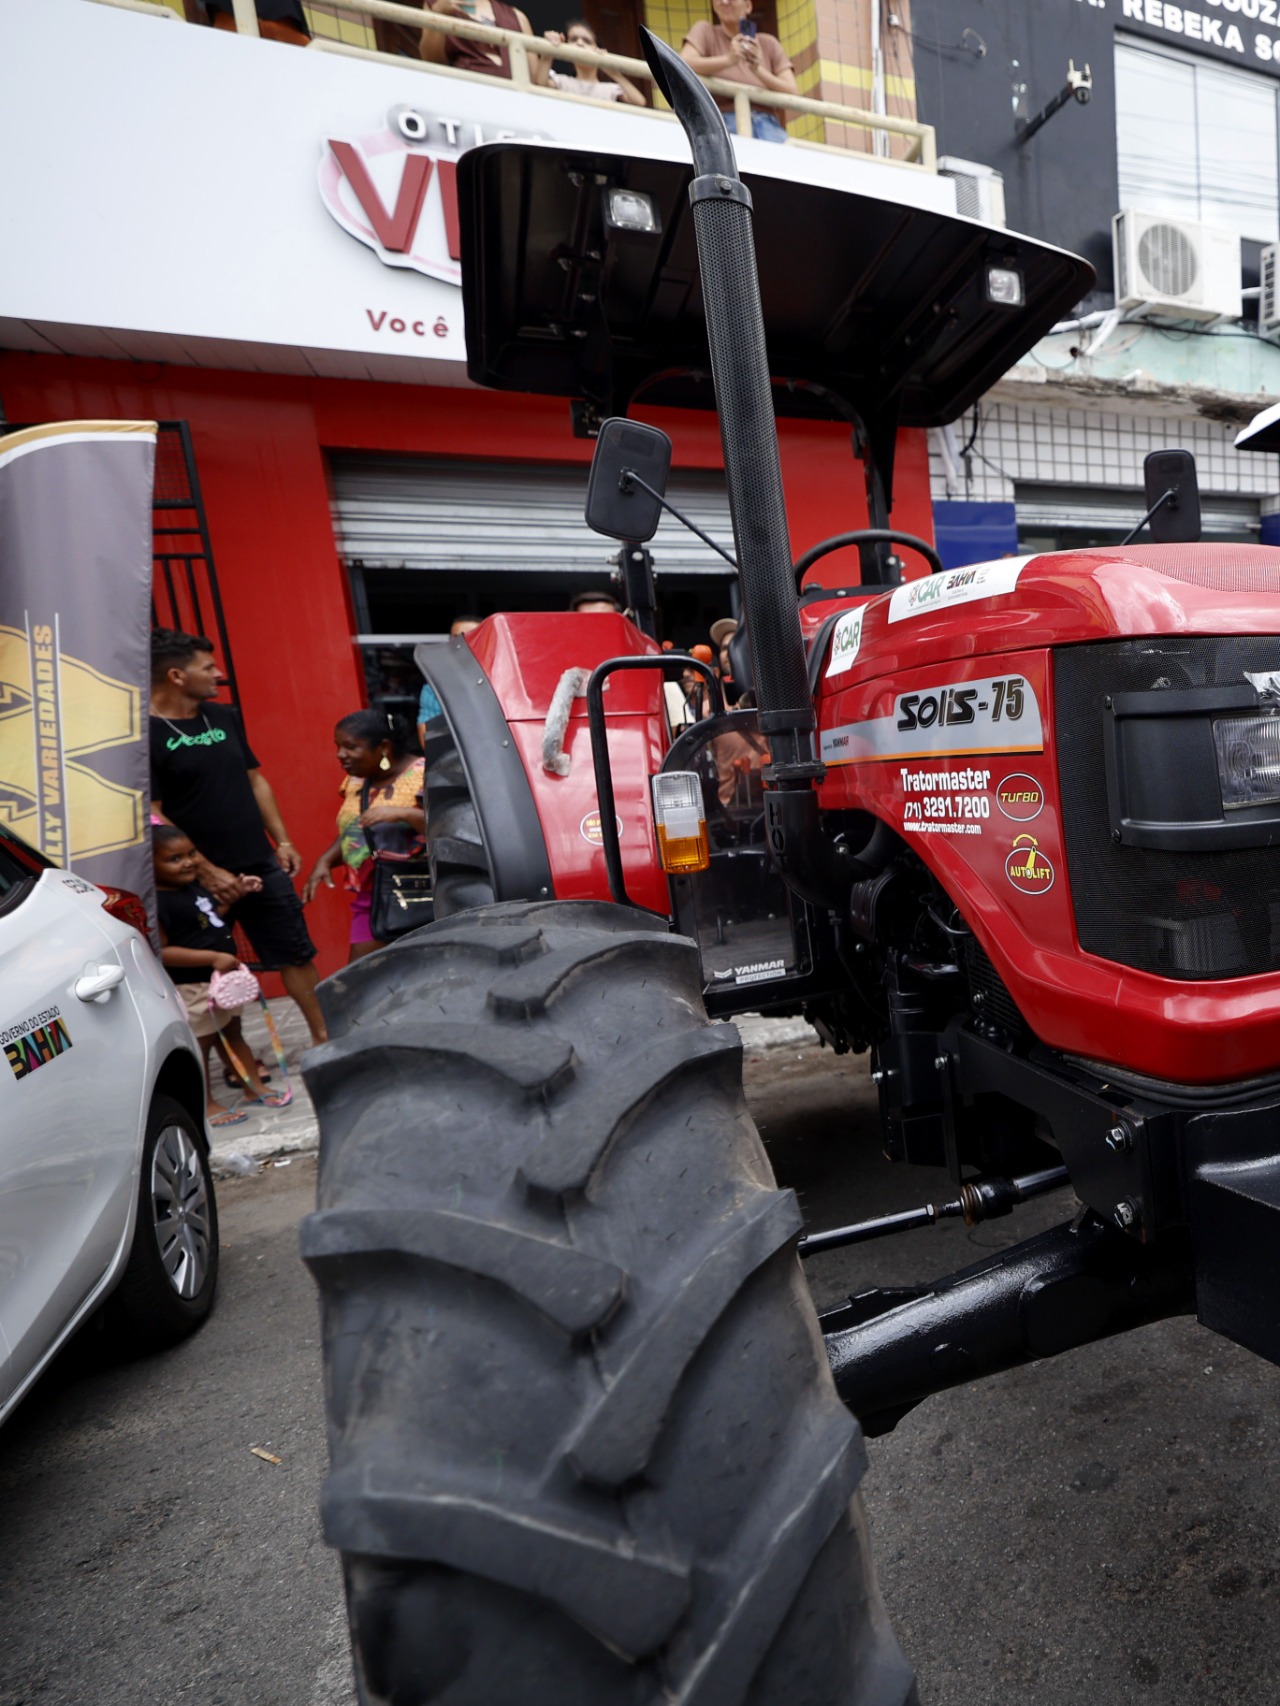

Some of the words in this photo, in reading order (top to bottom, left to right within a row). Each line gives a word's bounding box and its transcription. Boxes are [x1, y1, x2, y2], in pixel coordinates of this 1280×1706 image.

[1122, 0, 1245, 53] REBEKA
[366, 308, 449, 338] Você
[917, 575, 947, 603] CAR
[840, 621, 860, 652] CAR
[33, 624, 60, 806] VARIEDADES
[900, 767, 991, 792] Tratormaster
[903, 801, 922, 820] (71)
[923, 796, 991, 819] 3291.7200
[903, 821, 982, 835] www.tratormaster.com
[1010, 865, 1051, 880] AUTOLIFT
[734, 959, 785, 976] YANMAR
[739, 969, 782, 983] PROTECTION
[28, 1016, 40, 1029] DO
[37, 1005, 61, 1024] ESTADO
[3, 1016, 73, 1081] BAHIA
